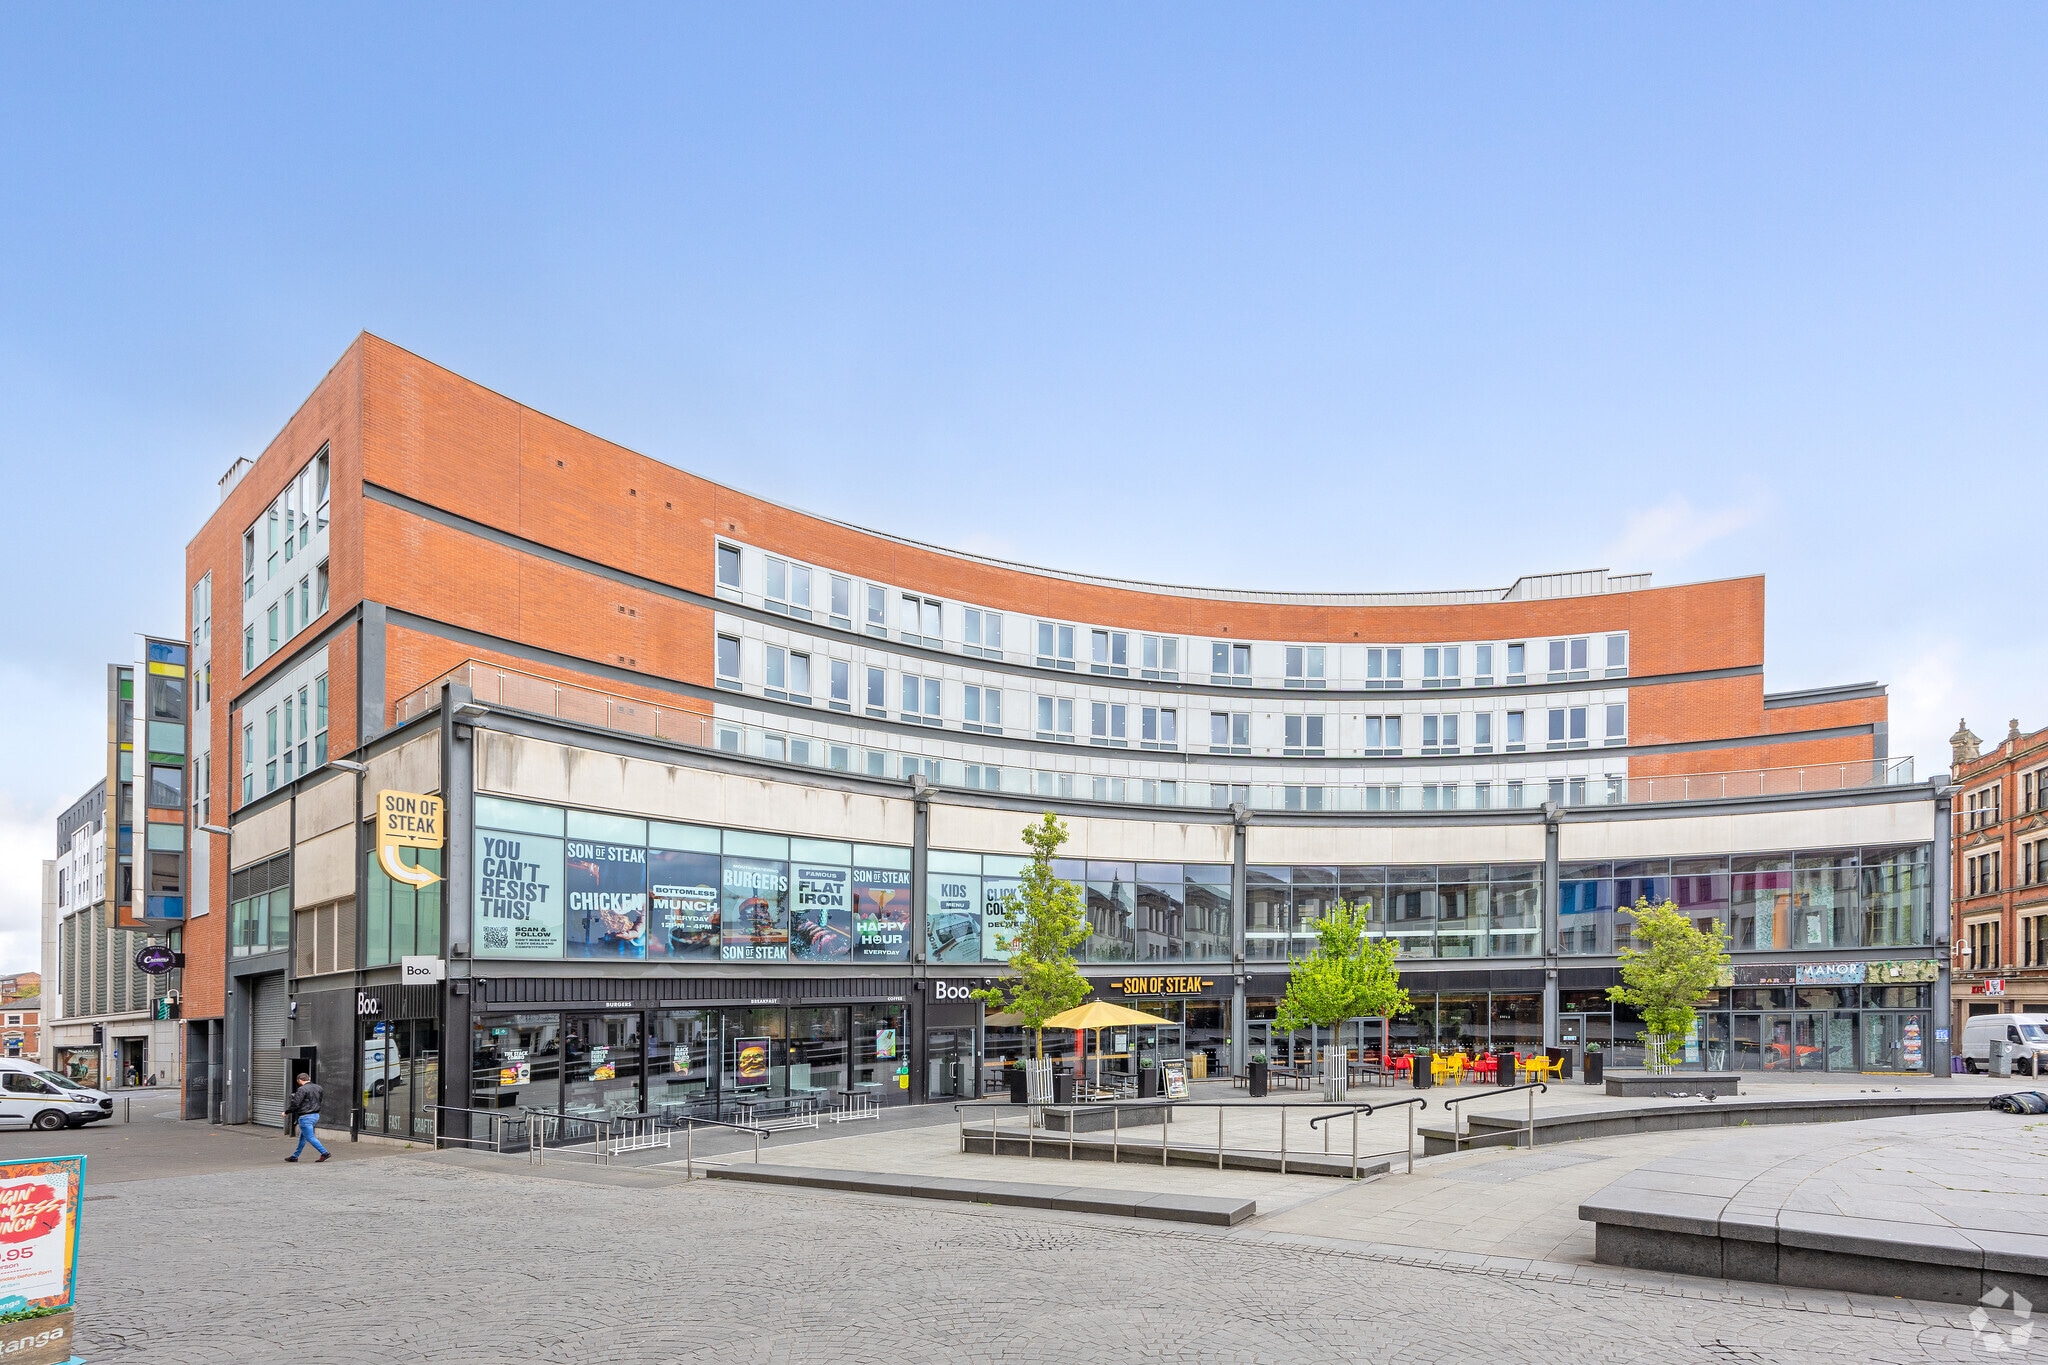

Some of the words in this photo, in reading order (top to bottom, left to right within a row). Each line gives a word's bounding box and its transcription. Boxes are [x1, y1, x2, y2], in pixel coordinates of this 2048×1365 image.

[385, 795, 416, 814] SON
[420, 800, 438, 816] OF
[388, 814, 436, 834] STEAK
[483, 836, 521, 860] YOU
[567, 842, 594, 860] SON
[596, 847, 606, 858] OF
[608, 848, 646, 864] STEAK
[482, 858, 540, 882] CAN'T
[805, 871, 837, 879] FAMOUS
[853, 870, 872, 882] SON
[874, 872, 881, 880] OF
[882, 872, 910, 884] STEAK
[723, 869, 788, 892] BURGERS
[798, 881, 844, 894] FLAT
[482, 878, 550, 902] RESIST
[655, 887, 716, 897] BOTTOMLESS
[941, 884, 967, 898] KIDS
[480, 897, 530, 920] THIS!
[570, 891, 647, 912] CHICKEN
[653, 899, 718, 912] MUNCH
[799, 893, 843, 906] IRON
[856, 921, 907, 932] HAPPY
[722, 946, 744, 959] SON
[746, 948, 754, 957] OF
[756, 946, 787, 959] STEAK
[406, 966, 432, 976] Boo.
[1804, 964, 1856, 974] MANOR
[936, 981, 972, 1000] Boo.
[1124, 977, 1148, 994] SON
[1150, 977, 1164, 993] OF
[1166, 976, 1202, 993] STEAK
[358, 992, 379, 1015] Boo.
[0, 1199, 62, 1221] MLESS
[0, 1216, 38, 1235] NCH
[0, 1246, 34, 1262] .95
